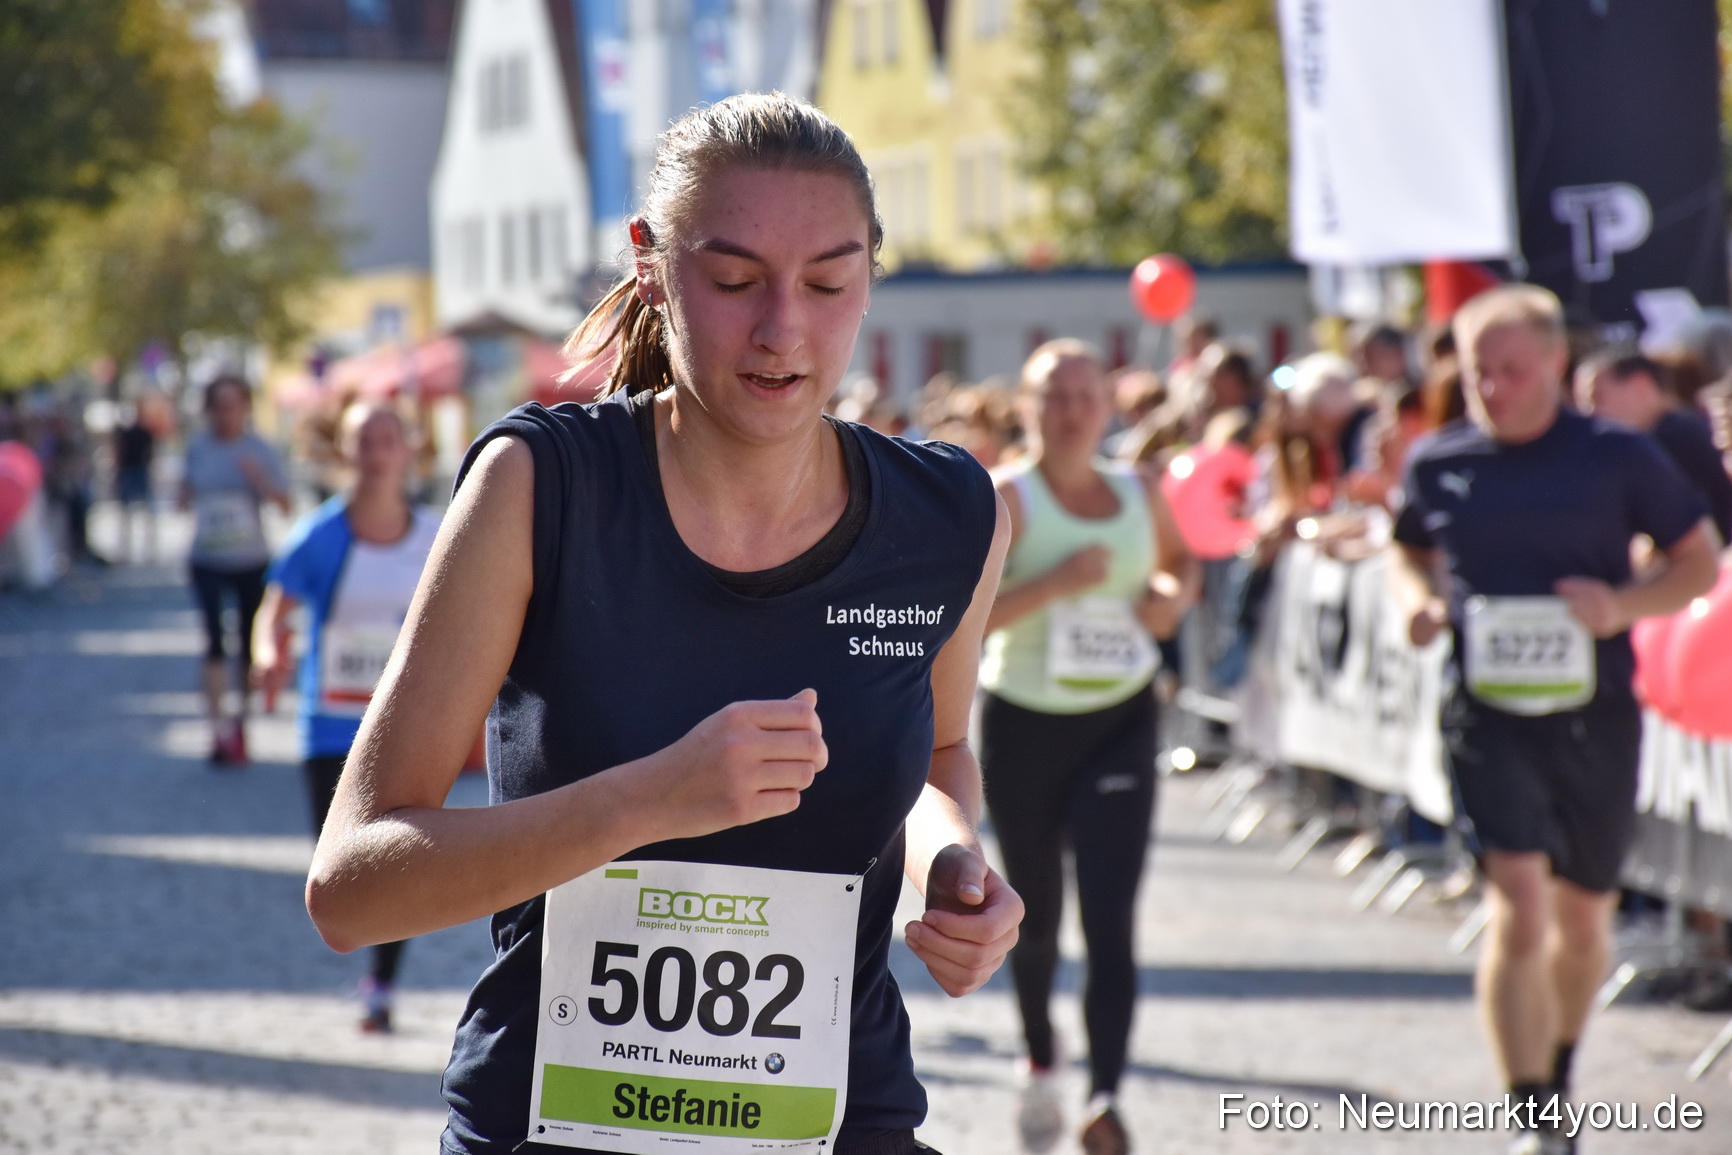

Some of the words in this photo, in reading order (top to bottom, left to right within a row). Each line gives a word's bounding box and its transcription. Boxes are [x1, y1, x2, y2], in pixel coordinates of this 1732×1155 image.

[826, 603, 945, 629] Landgasthof
[848, 635, 925, 657] Schnaus
[638, 887, 770, 926] BOCK
[636, 918, 677, 931] inspired
[680, 921, 692, 933] by
[694, 924, 724, 935] smart
[726, 927, 770, 938] concepts
[587, 940, 805, 1040] 5082
[557, 1002, 568, 1019] S
[602, 1041, 664, 1063] PARTL
[669, 1050, 758, 1070] Neumarkt
[612, 1082, 761, 1129] Stefanie
